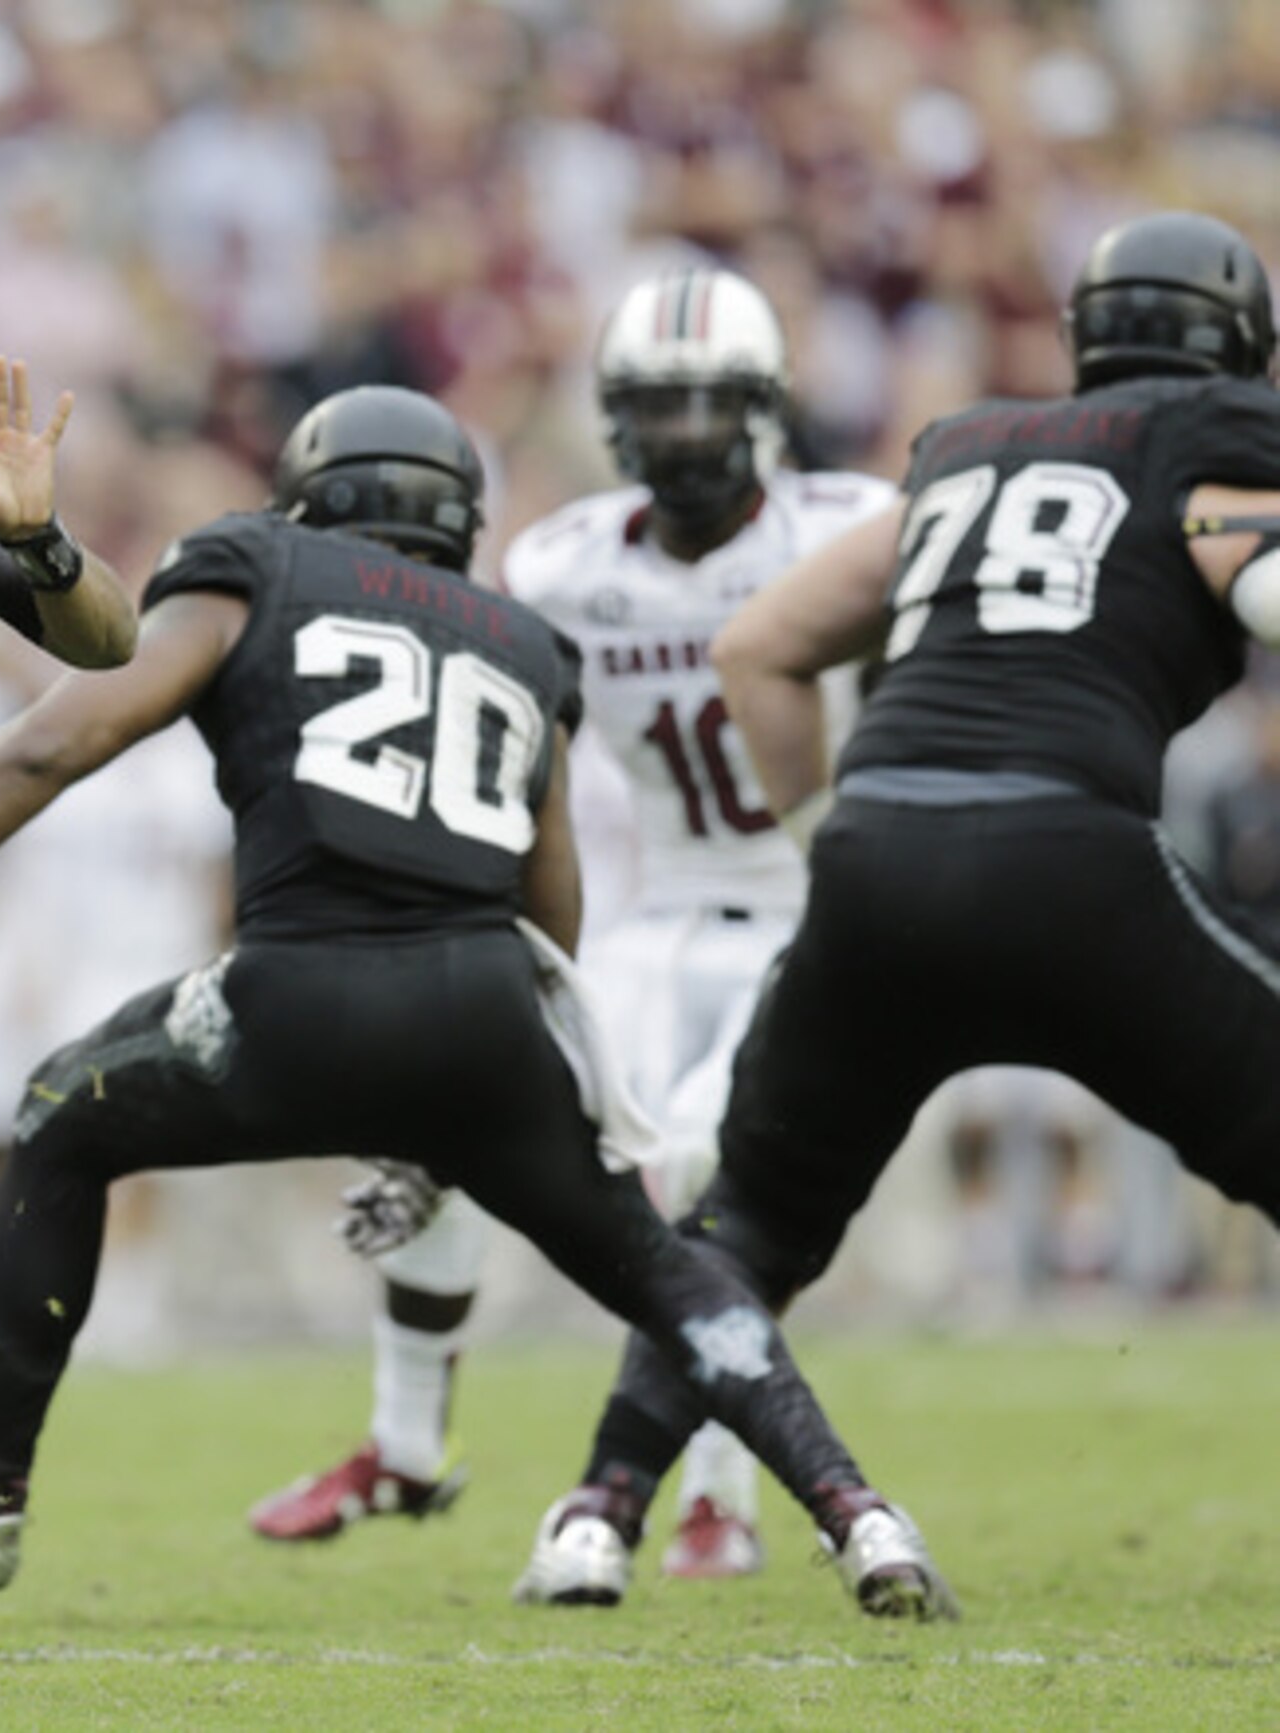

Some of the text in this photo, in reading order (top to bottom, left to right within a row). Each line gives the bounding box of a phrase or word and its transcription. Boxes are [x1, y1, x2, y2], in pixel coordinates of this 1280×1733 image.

[353, 559, 513, 646] WHITE
[884, 461, 1132, 663] 78
[294, 614, 545, 856] 20
[645, 697, 780, 838] 10
